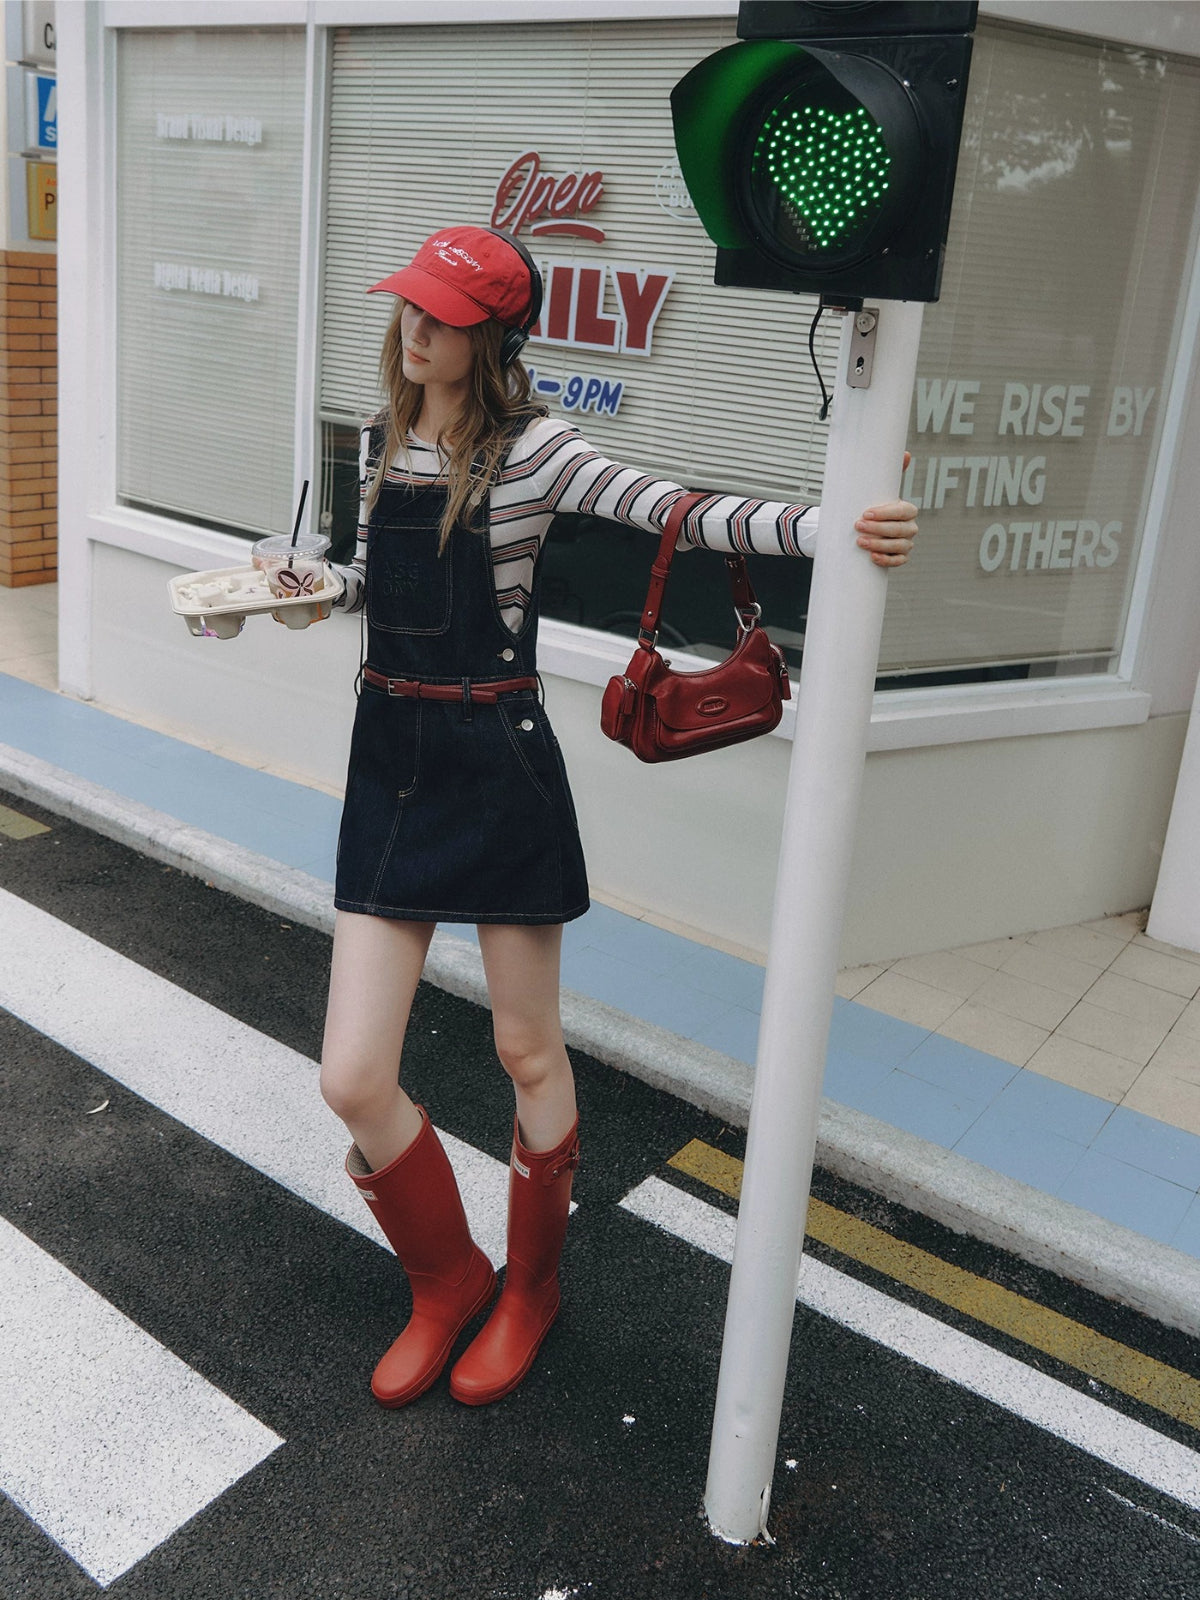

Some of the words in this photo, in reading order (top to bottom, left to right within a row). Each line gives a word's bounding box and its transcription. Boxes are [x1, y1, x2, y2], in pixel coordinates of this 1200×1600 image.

[491, 151, 604, 237] Open
[529, 262, 676, 357] ILY
[916, 378, 980, 435] WE
[998, 382, 1090, 437] RISE
[1106, 386, 1155, 437] BY
[903, 456, 1046, 509] LIFTING
[978, 520, 1122, 572] OTHERS
